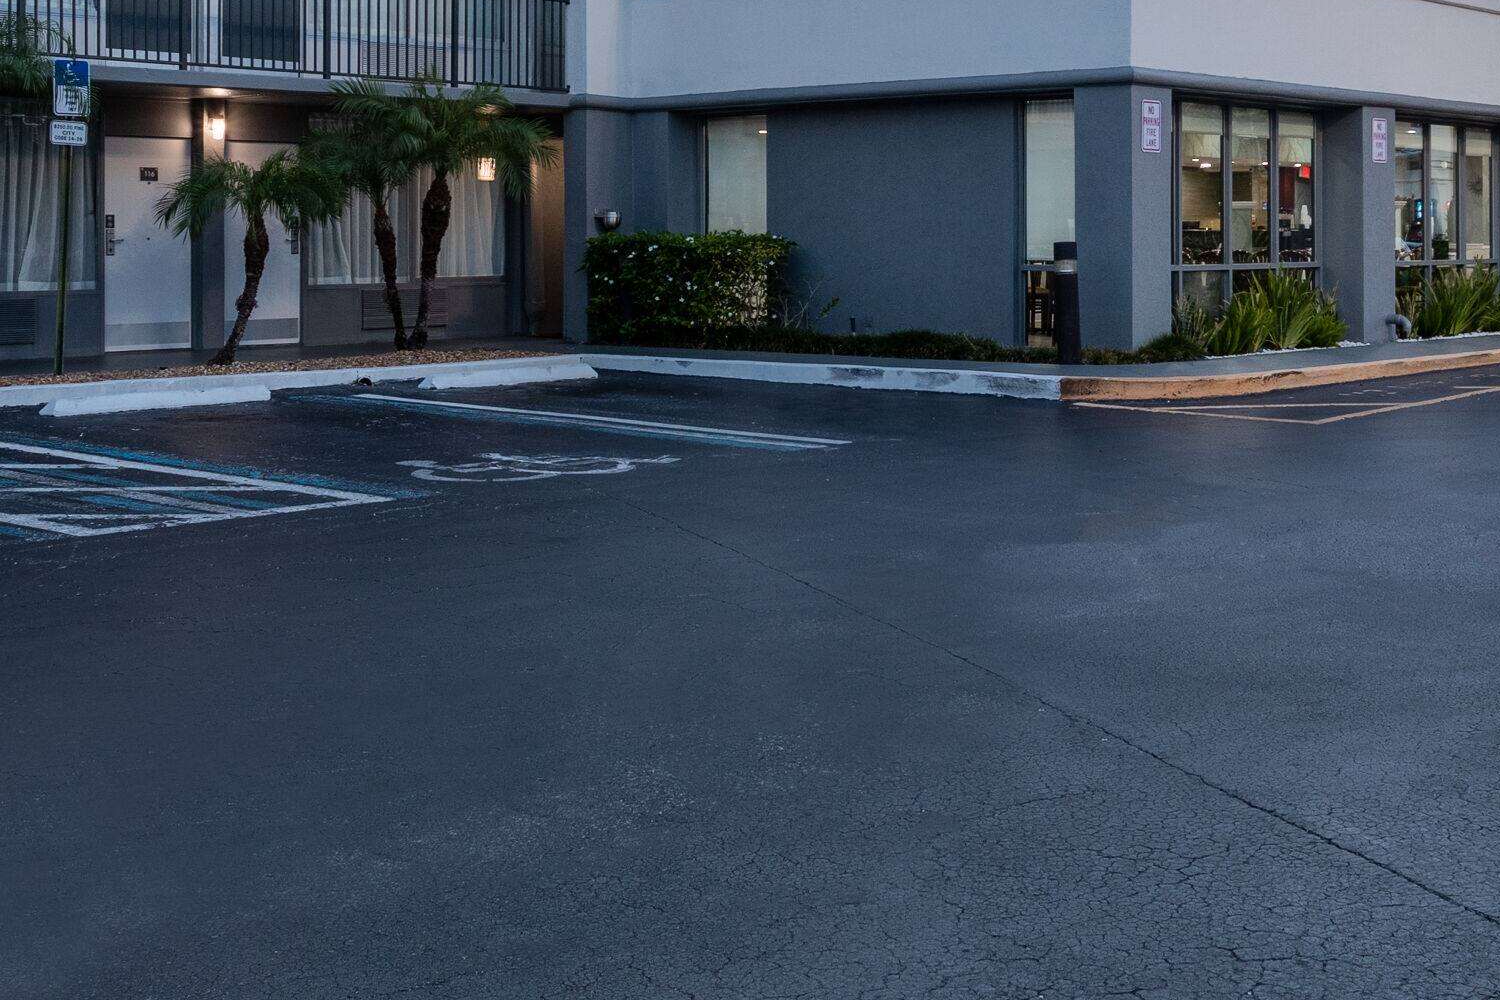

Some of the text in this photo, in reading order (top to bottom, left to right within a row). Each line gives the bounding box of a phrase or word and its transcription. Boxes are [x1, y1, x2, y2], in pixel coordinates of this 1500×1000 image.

[1147, 105, 1155, 114] NO
[1143, 116, 1160, 126] PARKING
[1146, 128, 1157, 136] FIRE
[1146, 139, 1157, 147] LANE
